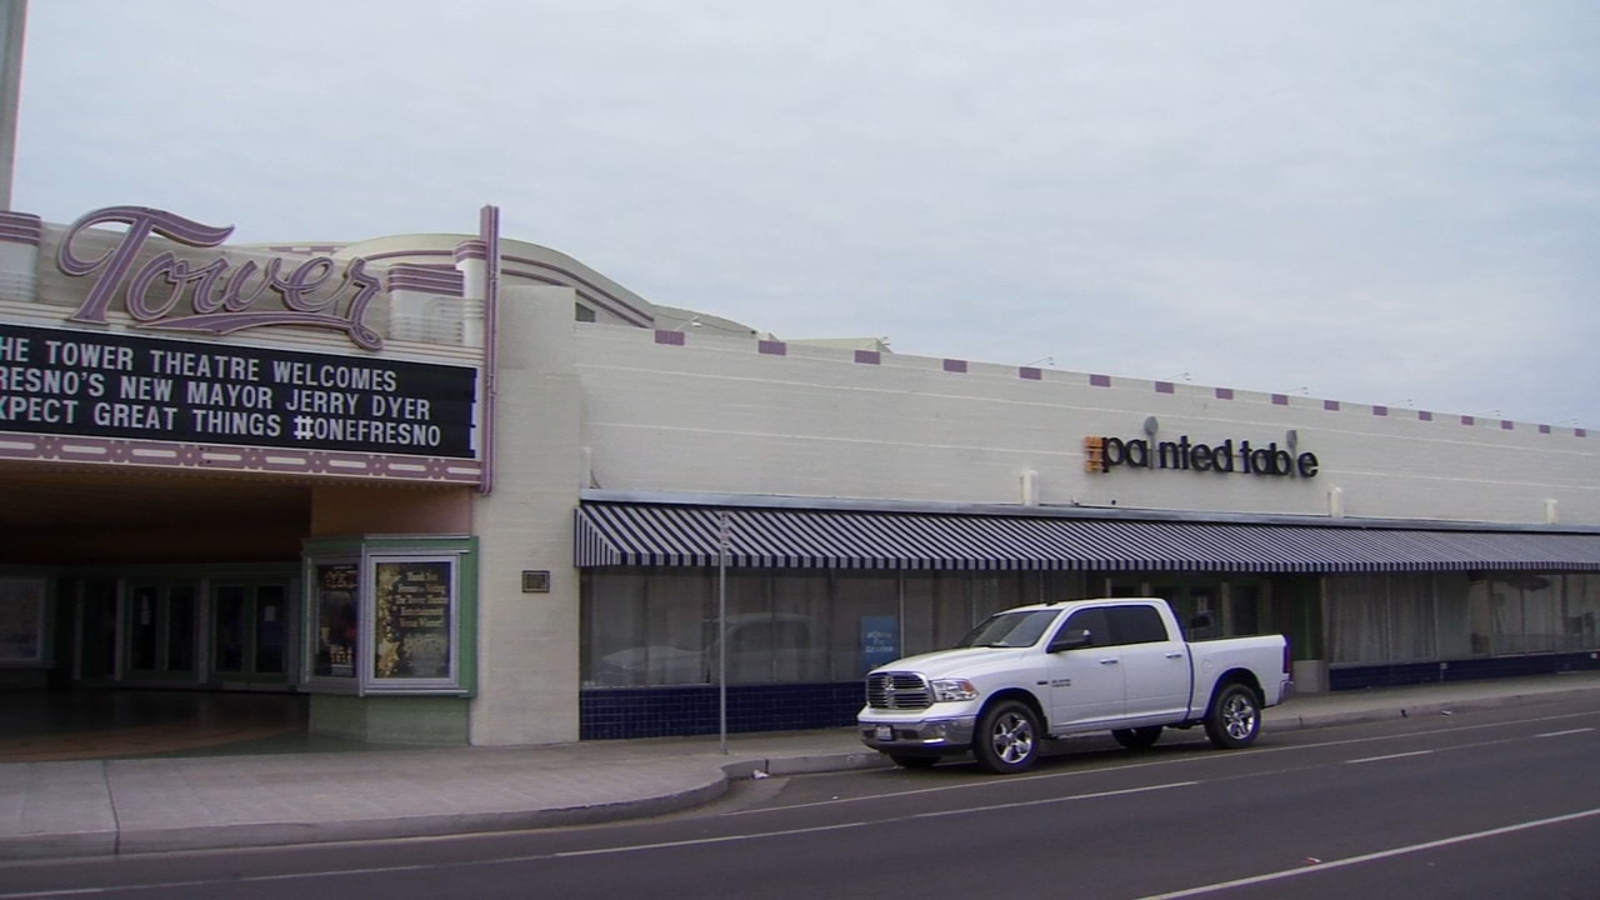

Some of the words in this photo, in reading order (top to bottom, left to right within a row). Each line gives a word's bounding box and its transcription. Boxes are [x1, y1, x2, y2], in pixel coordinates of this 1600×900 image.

[56, 205, 383, 350] Tower
[45, 340, 134, 371] TOWER
[150, 350, 260, 381] THEATRE
[273, 360, 397, 392] WELCOMES
[120, 375, 173, 402] NEW
[187, 381, 273, 409] MAYOR
[286, 389, 359, 415] JERRY
[372, 396, 430, 420] DYER
[94, 402, 178, 430] GREAT
[192, 409, 281, 437] THINGS
[294, 415, 441, 446] #ONEFRESNO
[1101, 416, 1233, 473] painted
[1239, 430, 1319, 478] table
